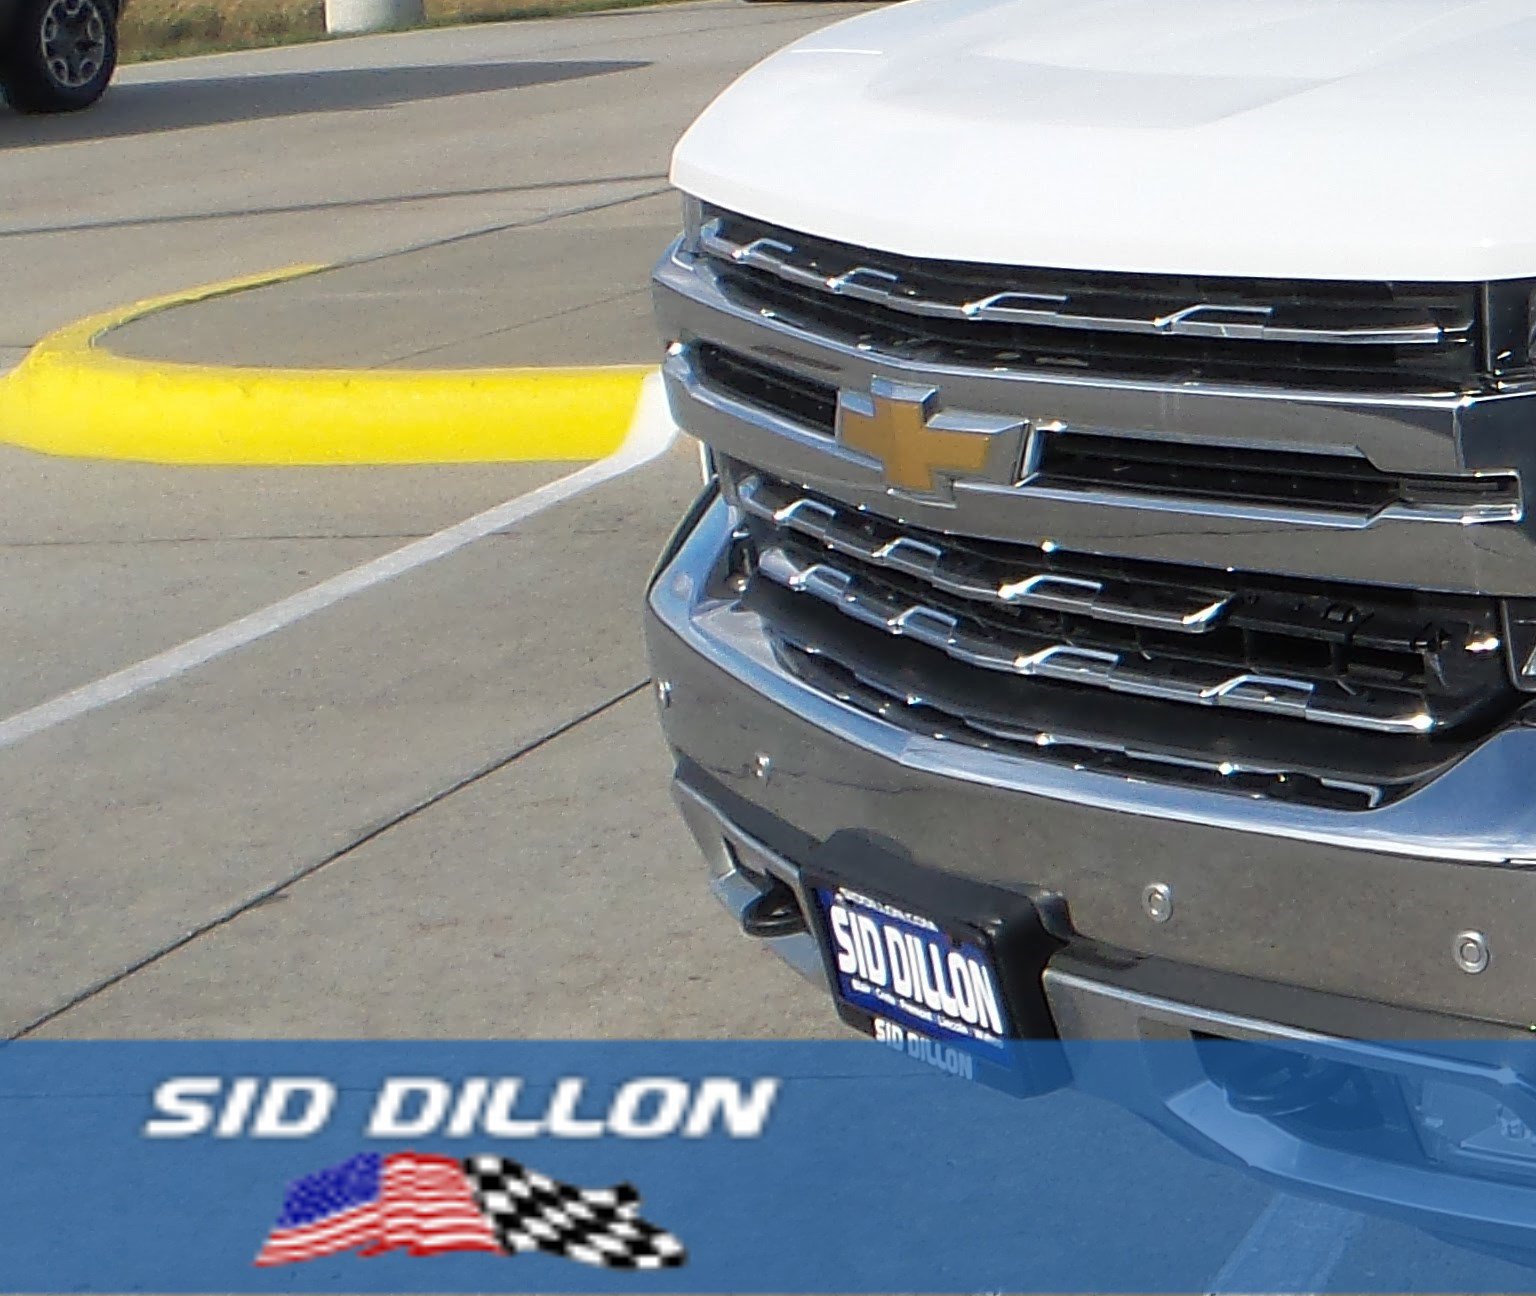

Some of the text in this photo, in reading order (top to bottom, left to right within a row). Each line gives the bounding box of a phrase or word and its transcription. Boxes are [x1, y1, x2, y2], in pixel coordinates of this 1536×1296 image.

[830, 904, 888, 988] SID
[883, 924, 1003, 1035] DILLON
[873, 1017, 973, 1080] SID DILLON
